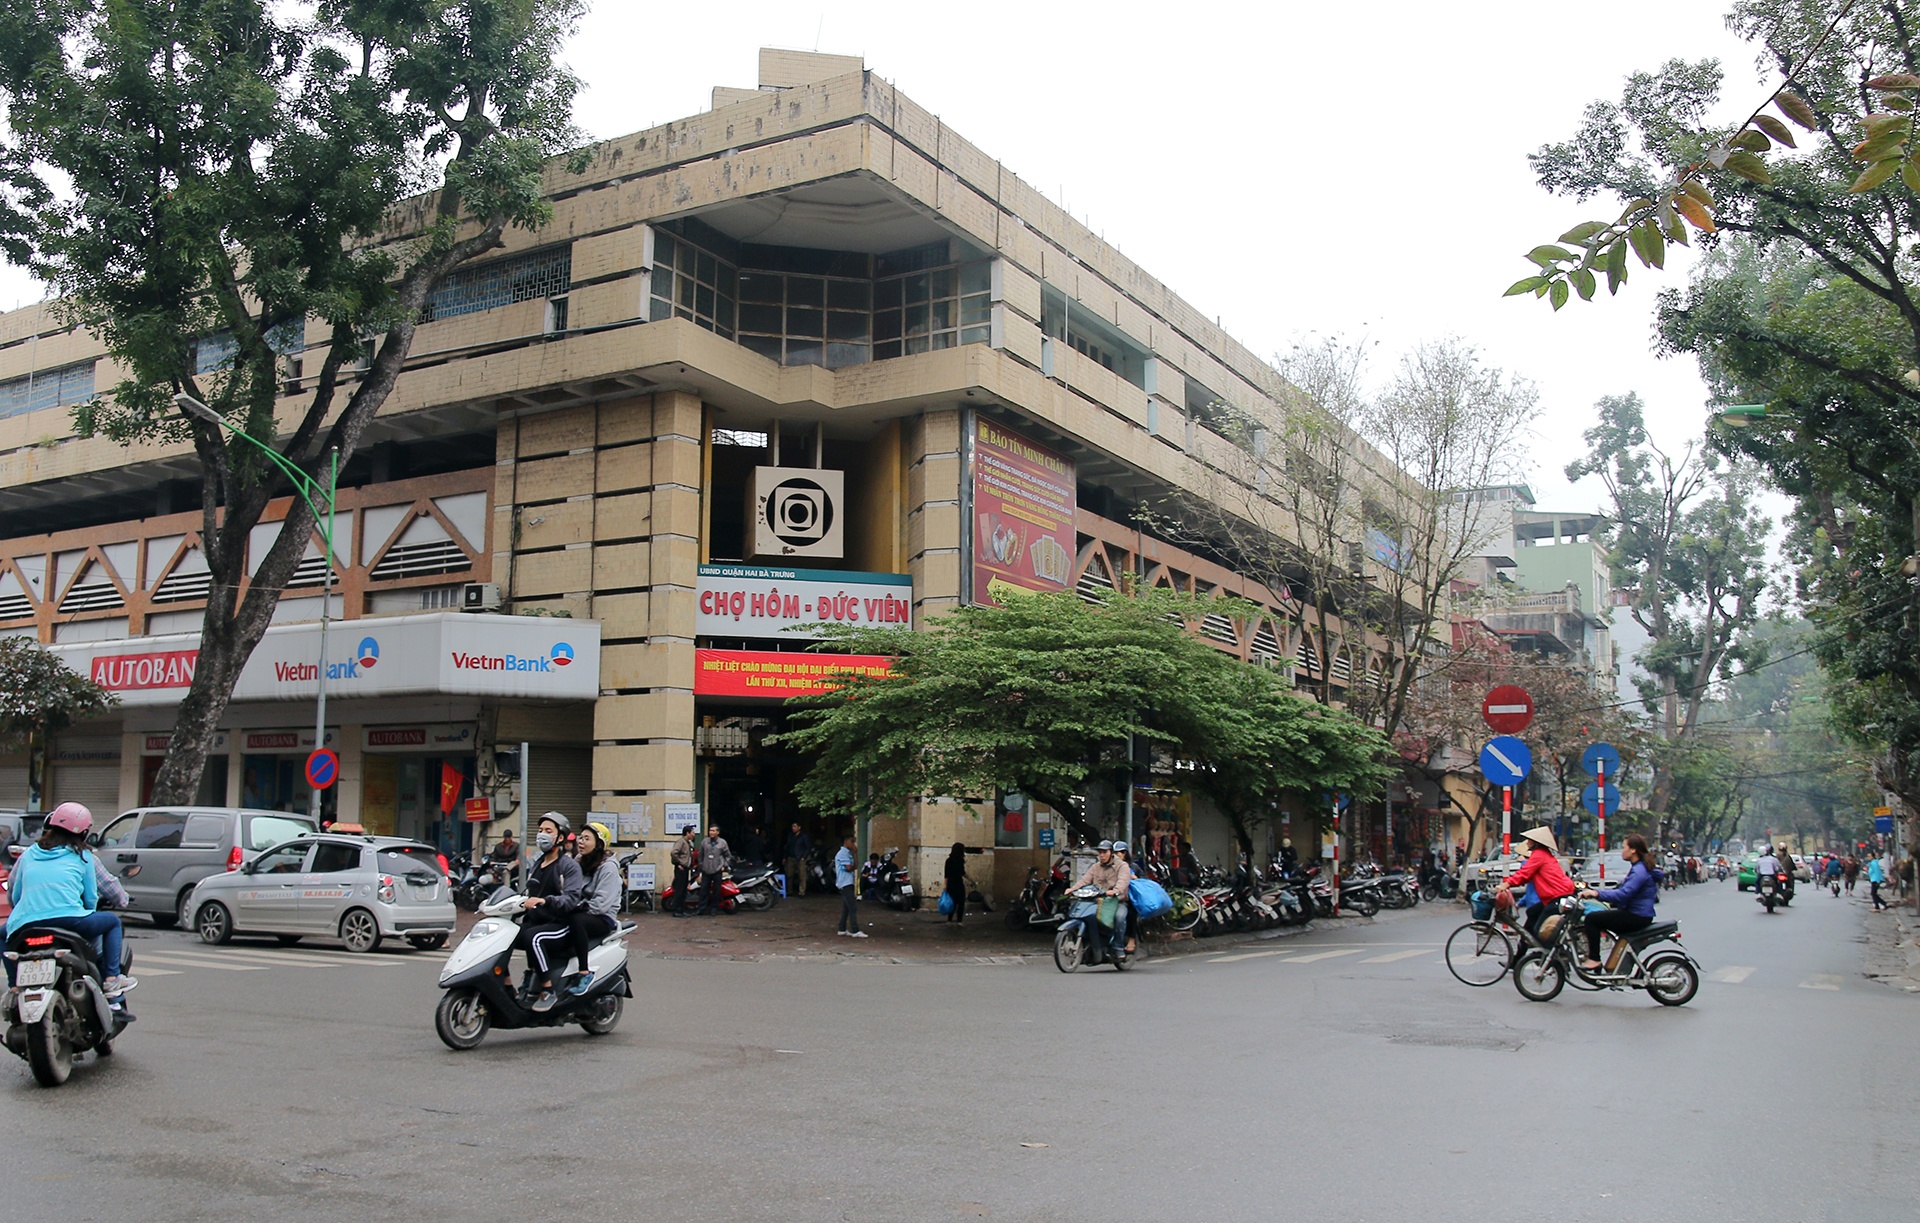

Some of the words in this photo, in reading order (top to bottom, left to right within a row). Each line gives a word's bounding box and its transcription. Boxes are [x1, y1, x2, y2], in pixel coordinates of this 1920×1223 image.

[990, 430, 1007, 449] BẢO
[1009, 438, 1022, 456] TÍN
[1023, 446, 1044, 467] MINH
[1045, 458, 1066, 476] CHÂU
[722, 568, 743, 577] QUẬN
[759, 569, 769, 577] BÀ
[700, 590, 746, 621] CHỢ
[751, 587, 799, 618] HÔM
[818, 591, 859, 621] ĐỨC
[864, 593, 908, 623] VIÊN
[452, 651, 550, 672] VietinBank
[703, 660, 724, 672] NHIỆT
[725, 660, 739, 673] LIỆT
[741, 661, 760, 672] CHÀO
[761, 662, 782, 673] MỪNG
[783, 664, 795, 675] ĐẠI
[797, 663, 808, 675] HỘI
[810, 665, 822, 676] ĐẠI
[867, 666, 884, 677] TOÀN
[95, 656, 197, 687] AUTOBAN
[761, 676, 775, 687] THỨ
[776, 678, 788, 688] XII,
[789, 677, 812, 690] NHIỆM
[250, 735, 296, 746] AUTOBANK
[370, 732, 424, 744] AUTOBANK
[24, 962, 49, 973] 29-K1
[20, 973, 51, 984] 619.72
